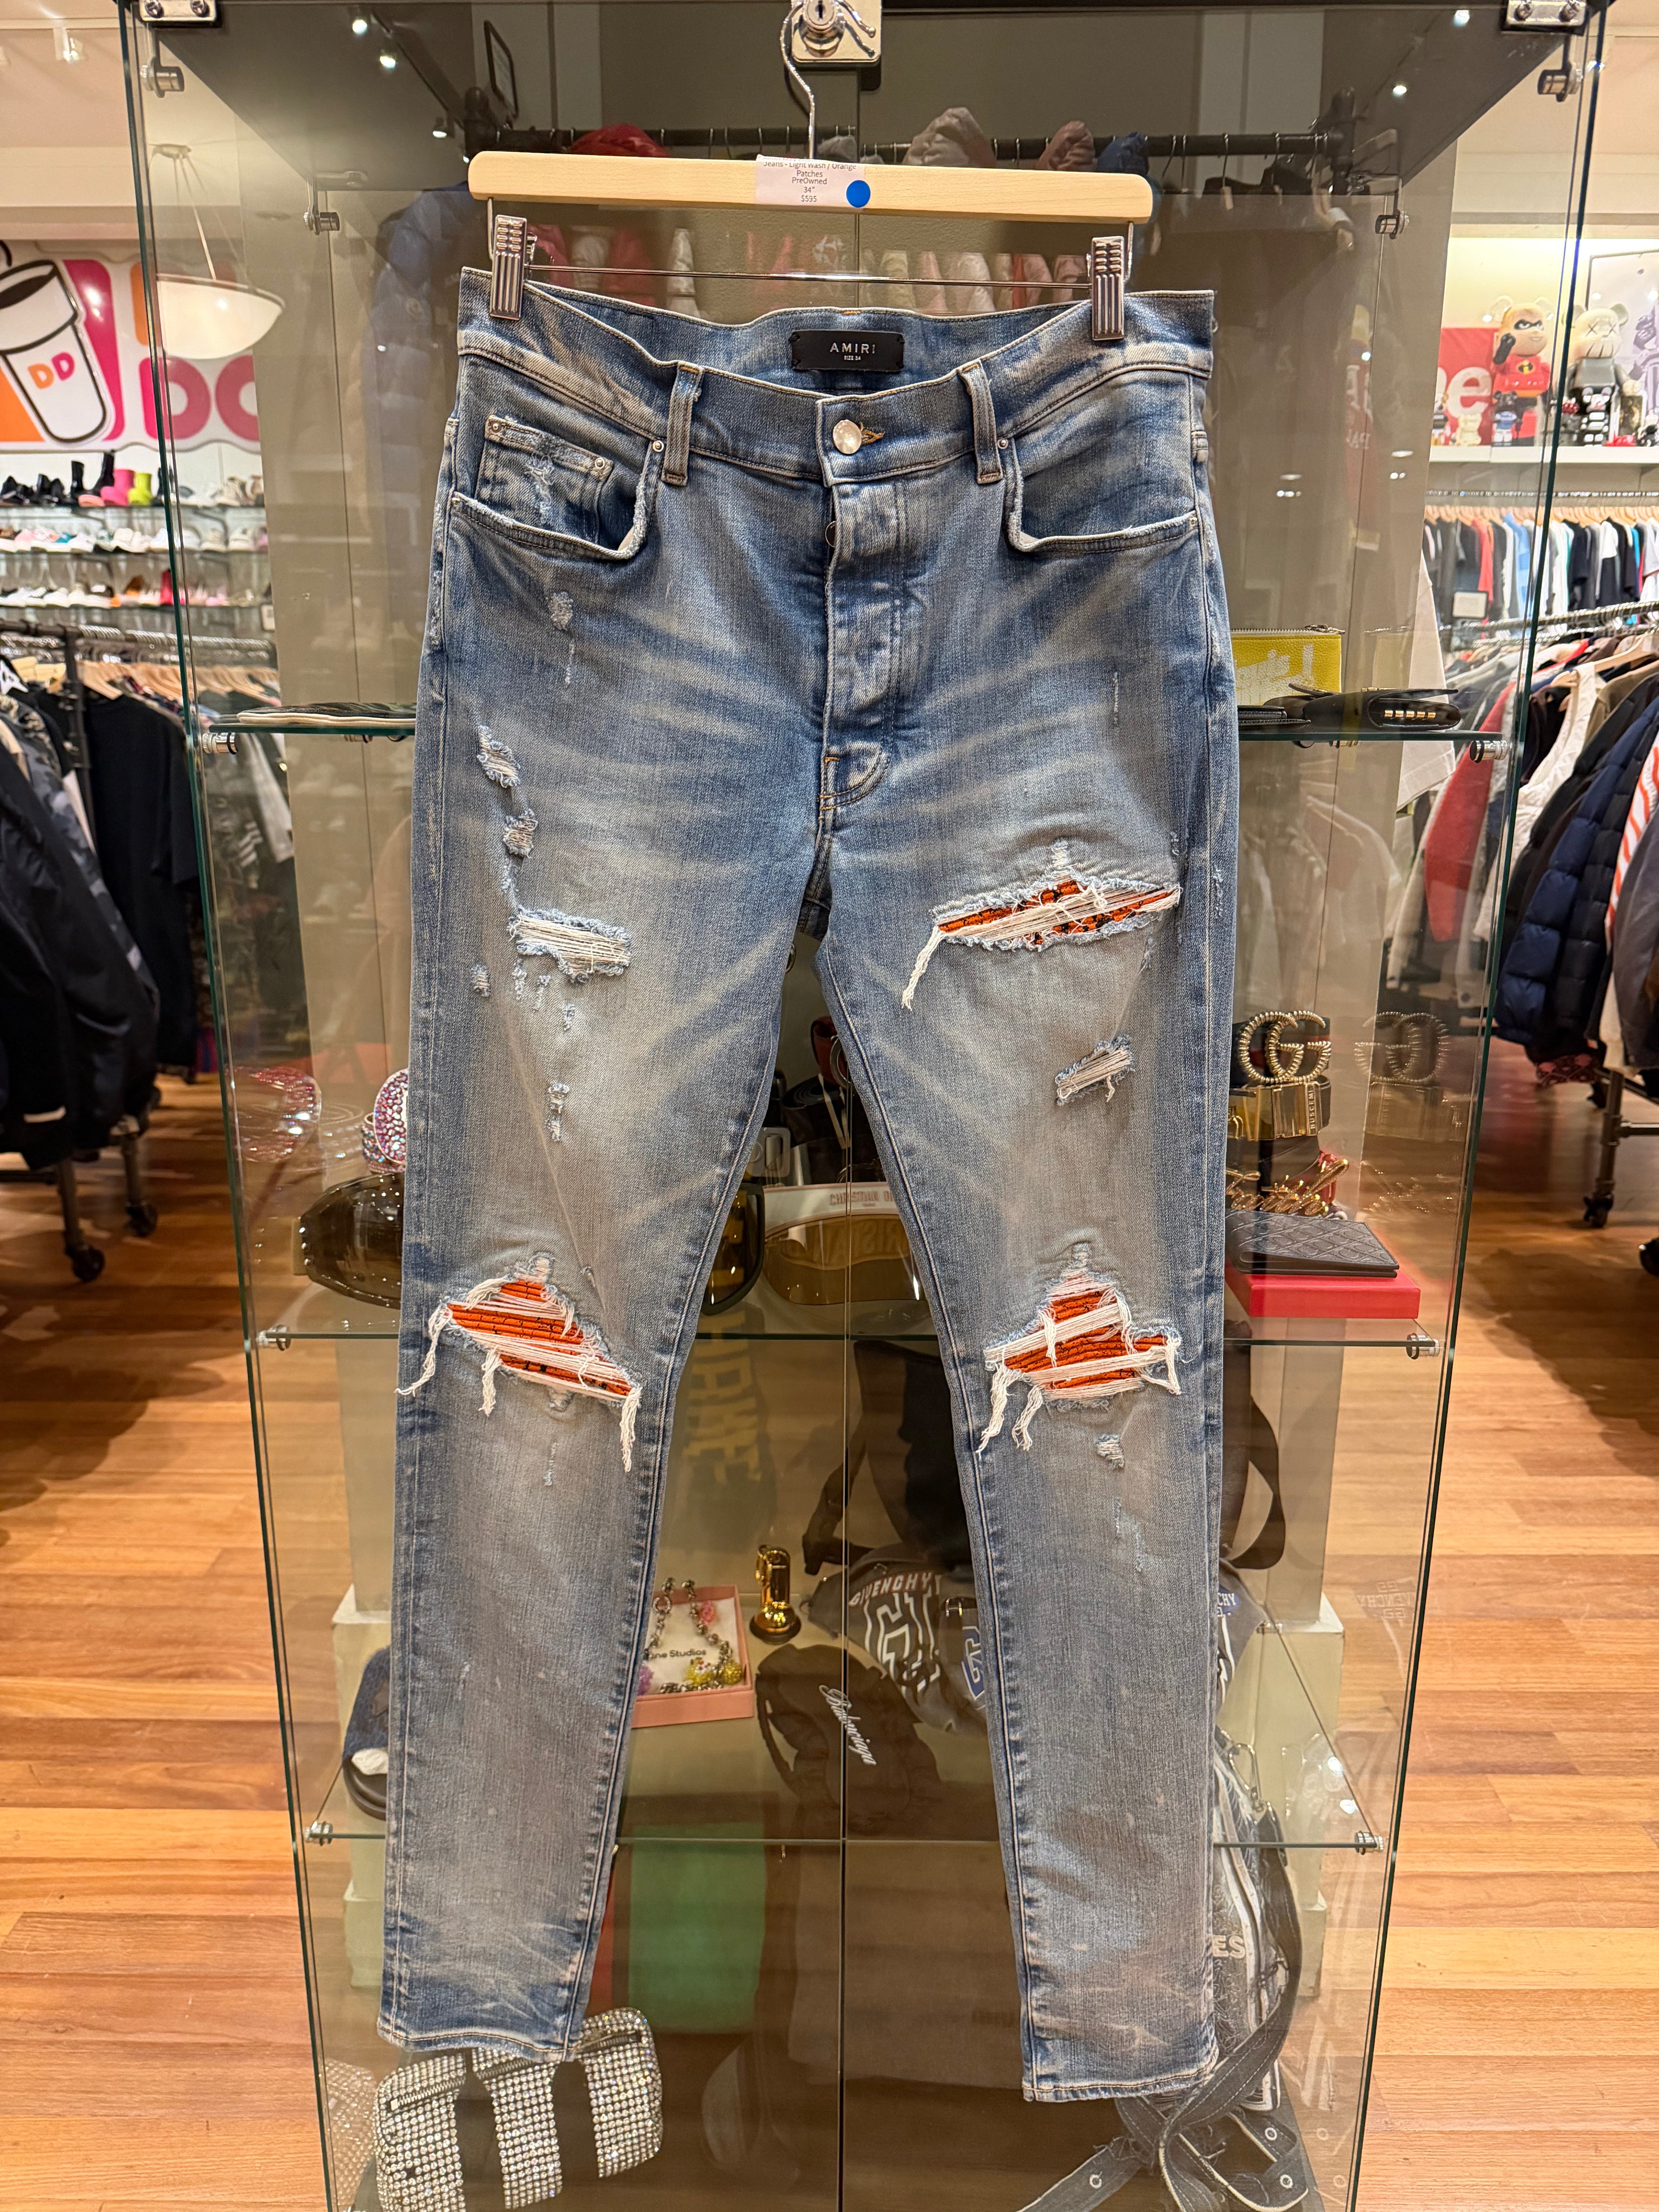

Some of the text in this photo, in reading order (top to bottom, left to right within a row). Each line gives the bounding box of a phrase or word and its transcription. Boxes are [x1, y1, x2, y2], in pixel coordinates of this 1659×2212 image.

[830, 342, 876, 354] AMIRI
[28, 352, 75, 389] DD
[849, 1572, 932, 1607] GIVENCHY
[669, 1648, 706, 1657] Studios
